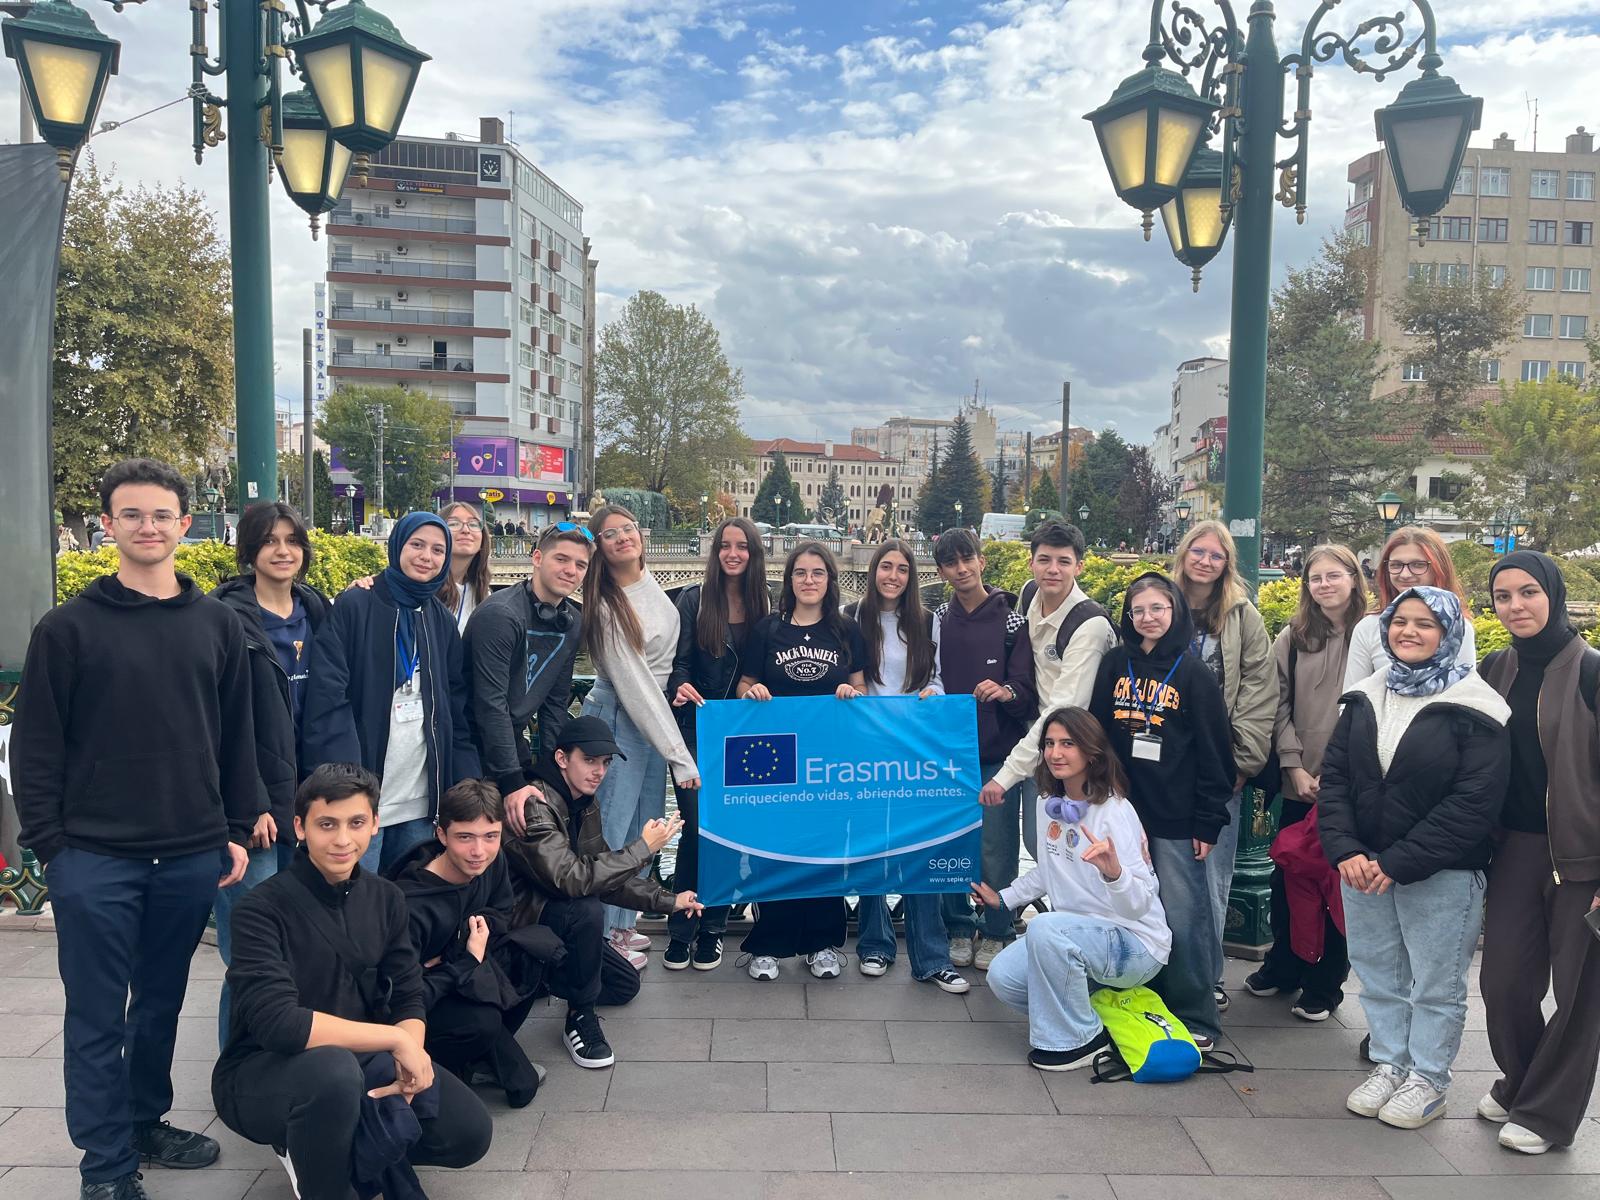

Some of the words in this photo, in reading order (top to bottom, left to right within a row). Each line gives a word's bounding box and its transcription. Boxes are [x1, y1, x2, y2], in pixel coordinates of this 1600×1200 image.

[316, 310, 325, 353] OTEL
[775, 647, 800, 665] JACK
[798, 645, 839, 666] DANIEL'S
[805, 757, 962, 784] Erasmus+
[723, 790, 814, 806] Enriqueciendo
[817, 789, 853, 802] vidas,
[856, 787, 913, 800] abriendo
[916, 785, 967, 798] mentes.
[928, 857, 971, 872] sepie
